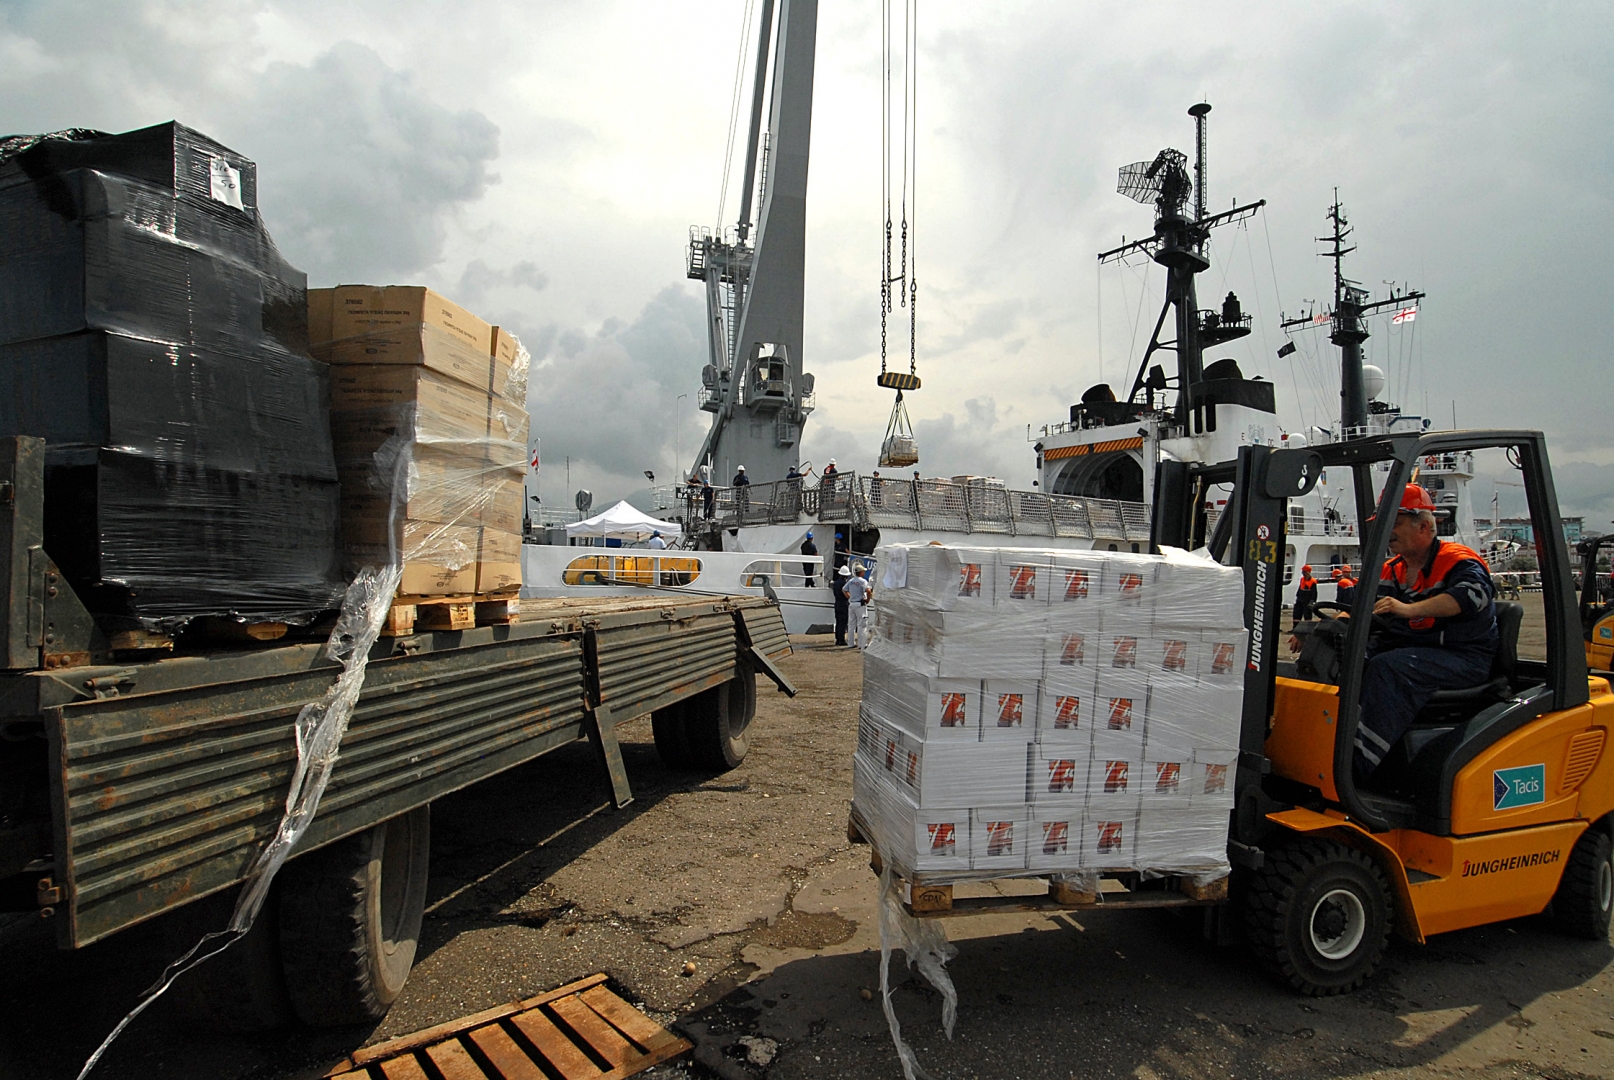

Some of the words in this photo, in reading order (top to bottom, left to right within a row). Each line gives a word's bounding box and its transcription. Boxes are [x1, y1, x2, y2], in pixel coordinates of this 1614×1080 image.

[1249, 560, 1267, 672] JUNGHEINRICH
[1513, 776, 1539, 795] Tacis
[1462, 849, 1561, 877] JUNGHEINRICH
